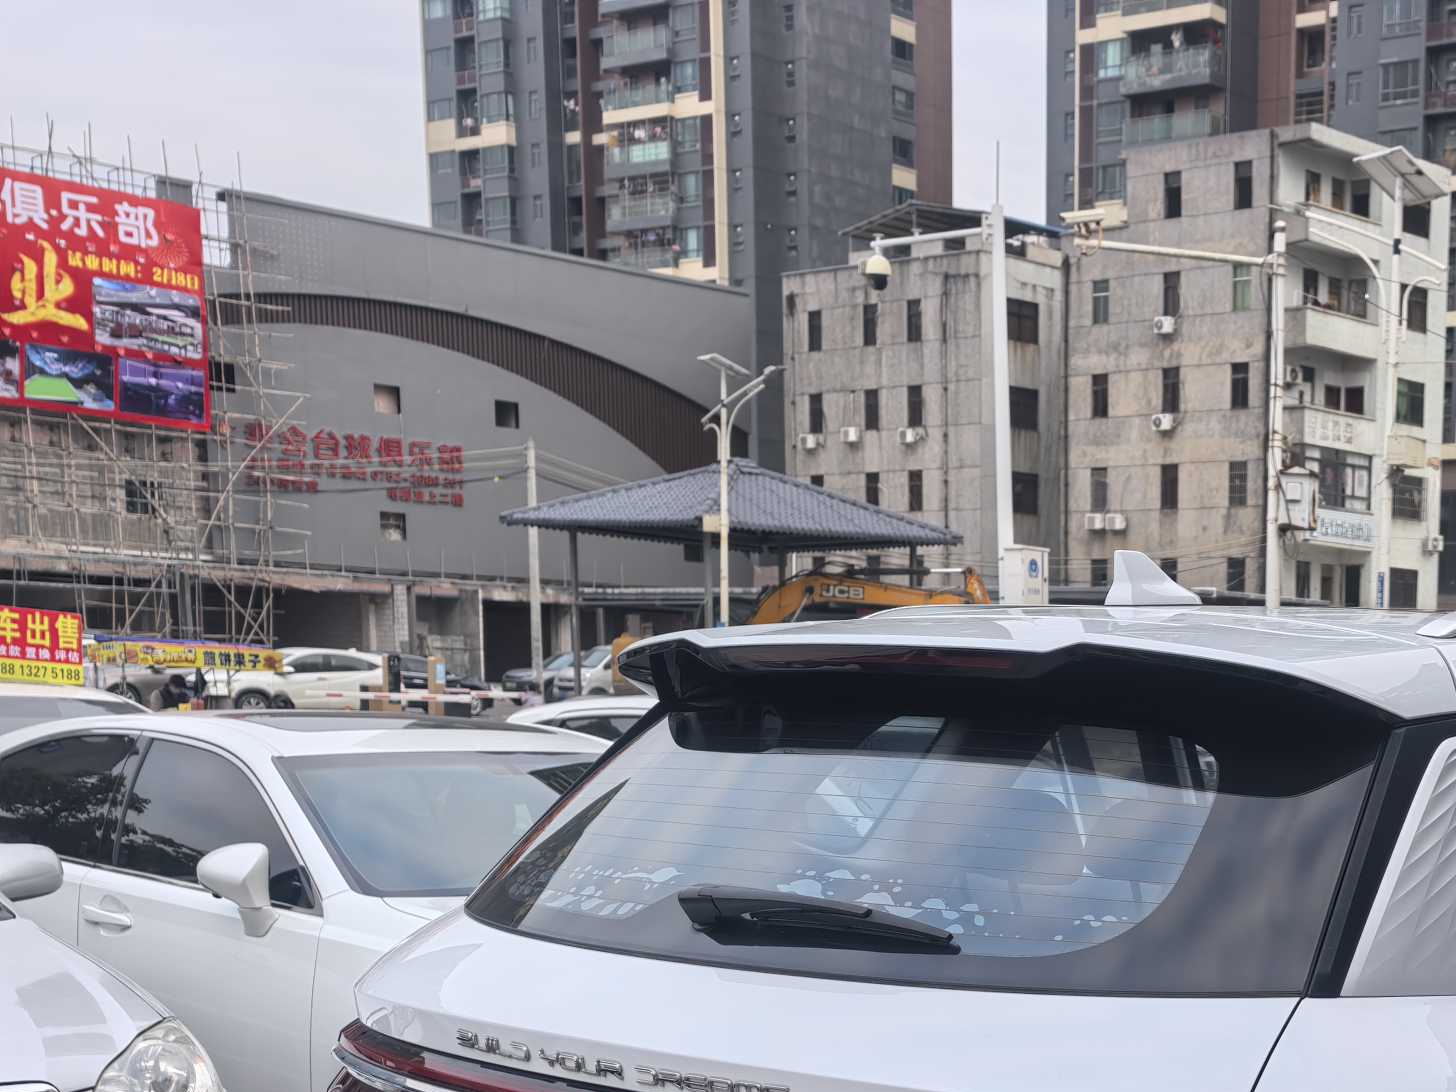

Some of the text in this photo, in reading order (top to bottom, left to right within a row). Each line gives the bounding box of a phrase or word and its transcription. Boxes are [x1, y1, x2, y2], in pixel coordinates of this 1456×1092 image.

[0, 178, 159, 249] 俱乐部
[0, 239, 89, 332] 业
[822, 584, 863, 599] JCB
[0, 608, 79, 650] 车出售
[20, 664, 47, 677] 1327
[50, 666, 81, 681] 5188
[456, 1027, 531, 1063] BUILD
[536, 1046, 625, 1082] YOUR
